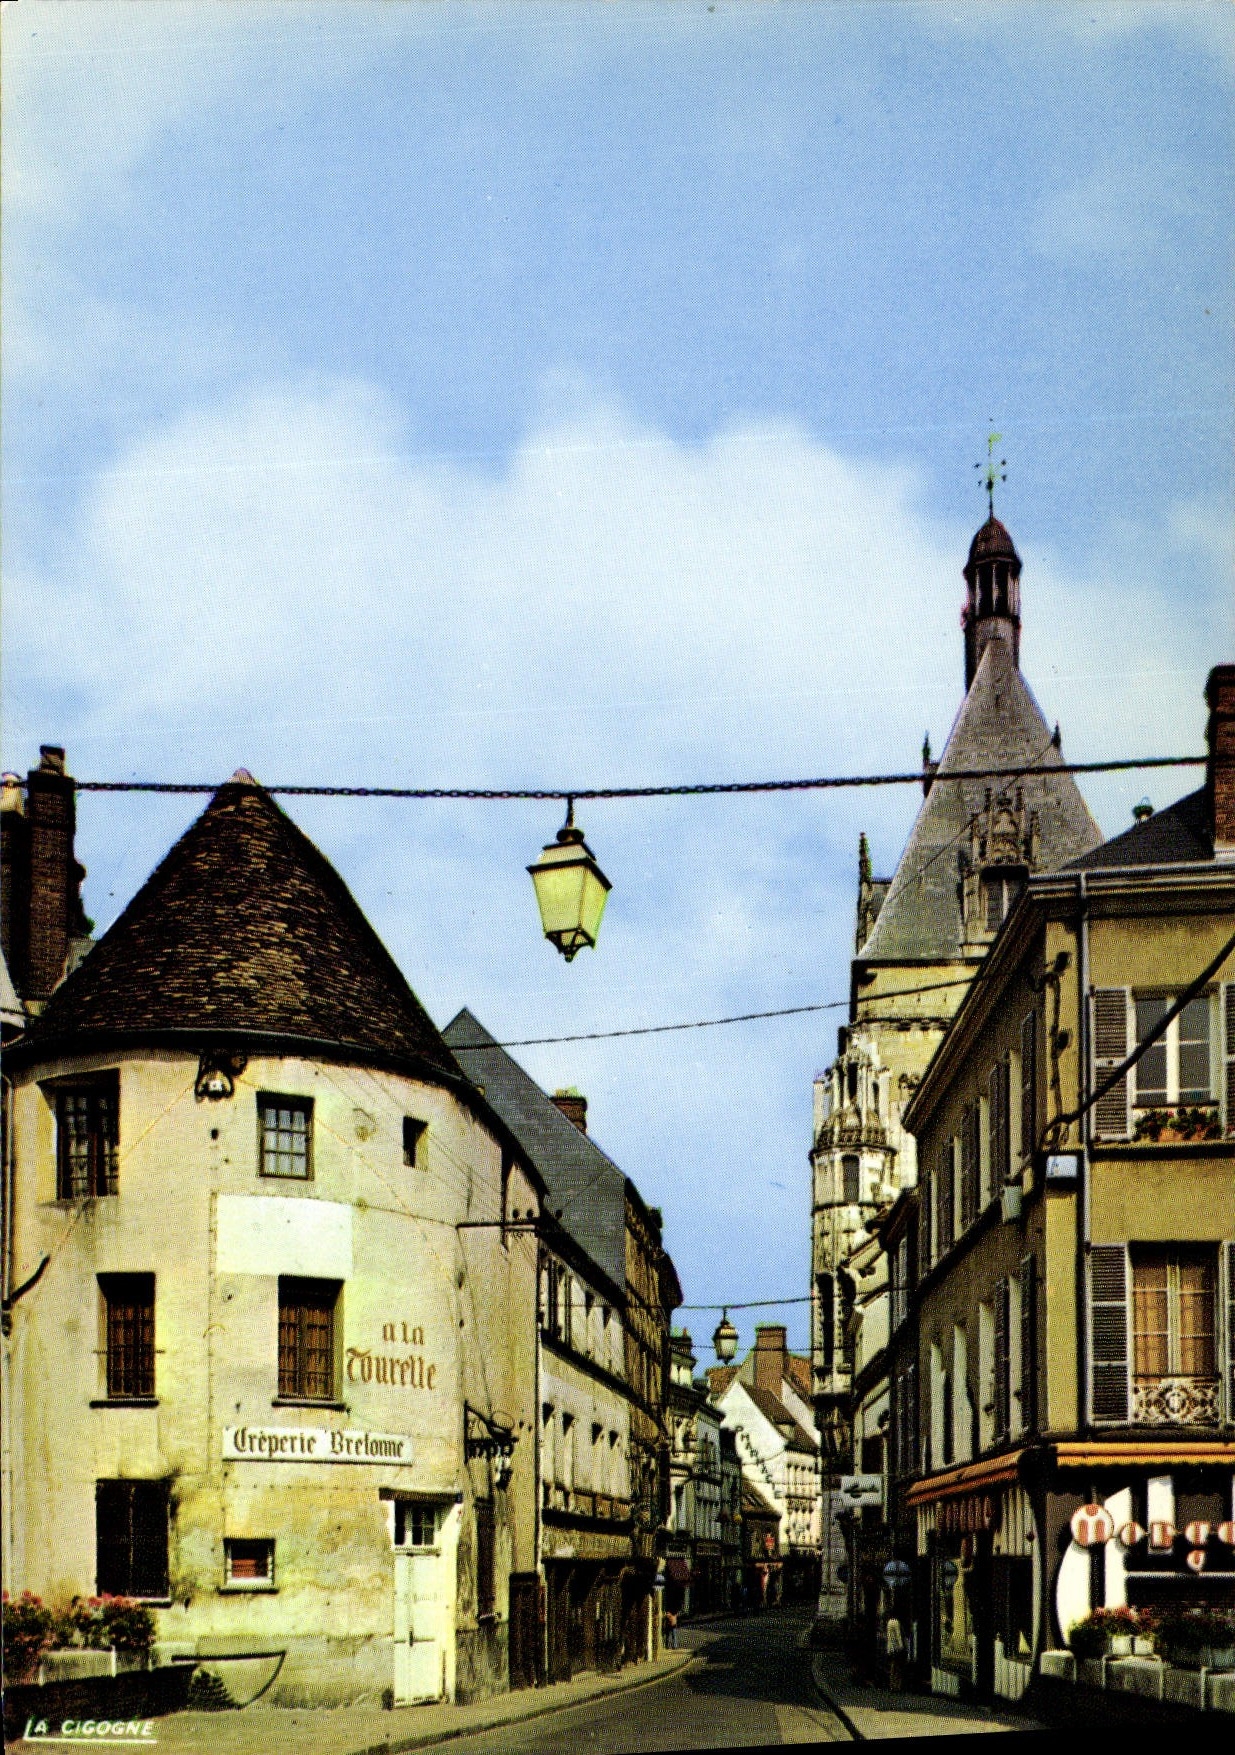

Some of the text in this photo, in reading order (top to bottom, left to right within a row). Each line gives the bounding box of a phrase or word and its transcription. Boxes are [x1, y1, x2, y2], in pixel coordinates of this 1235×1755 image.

[401, 1321, 425, 1346] la
[346, 1347, 437, 1391] Tourelle
[330, 1429, 405, 1459] Bretonne
